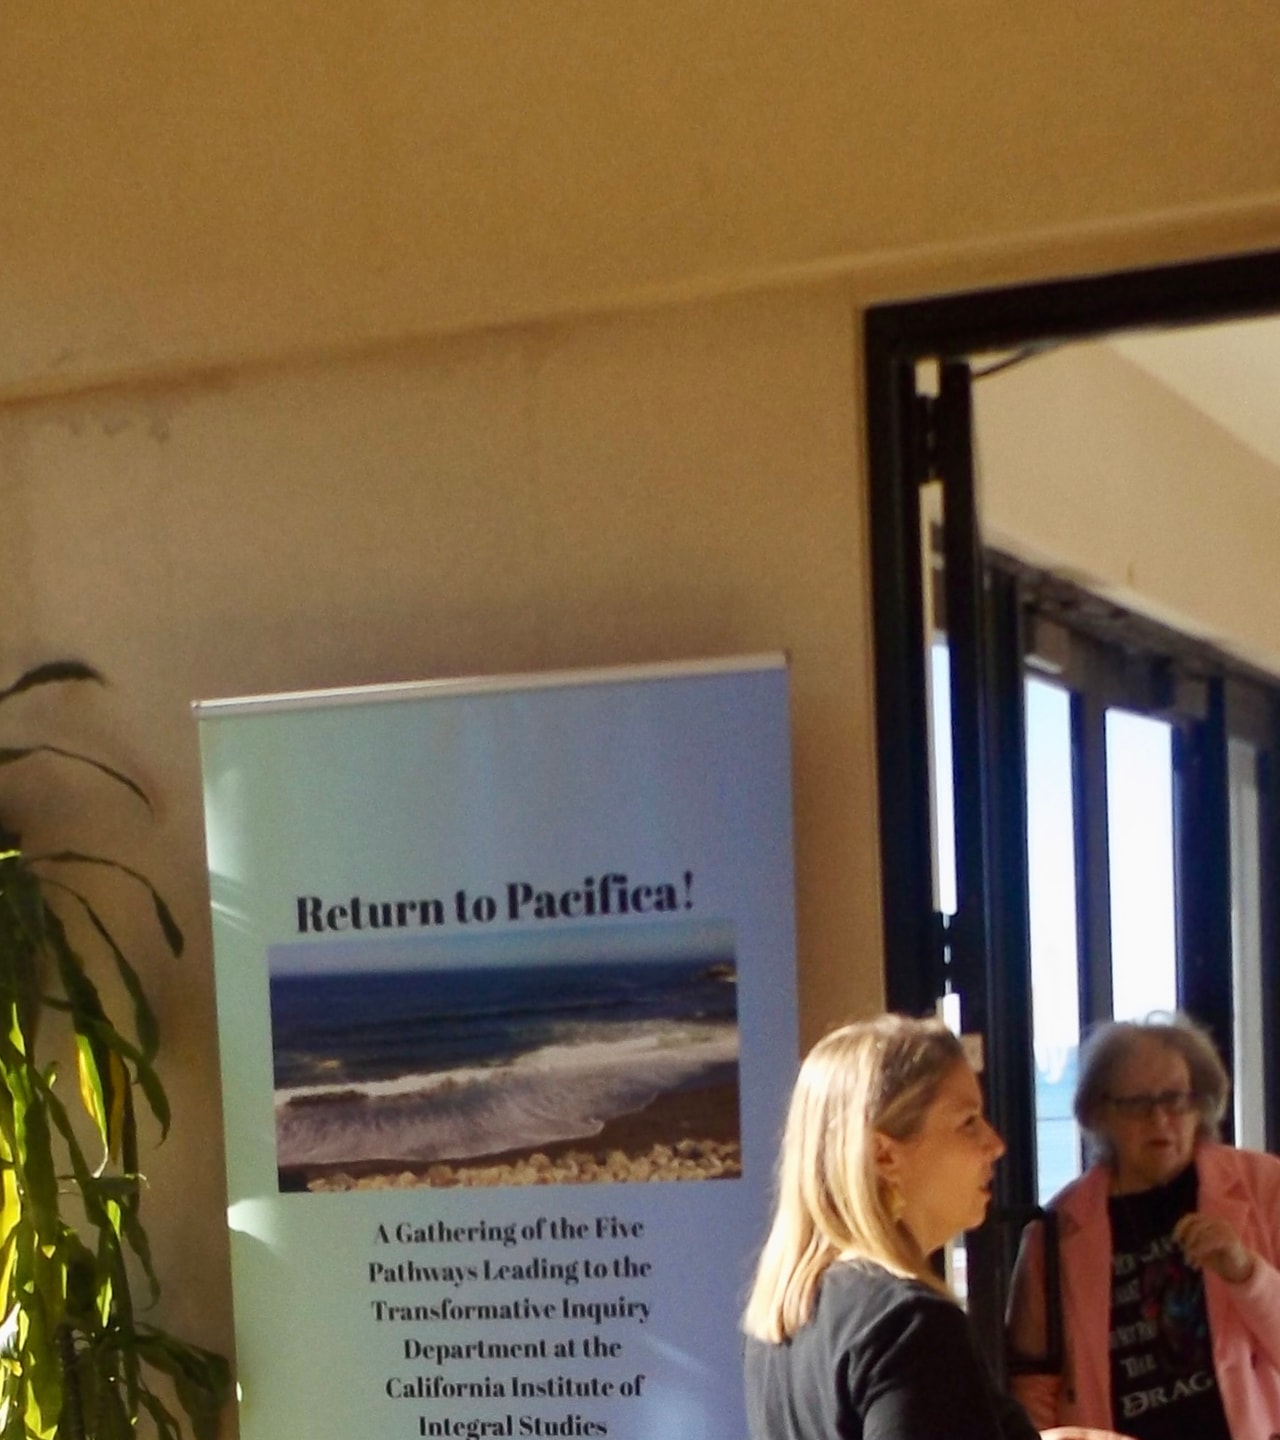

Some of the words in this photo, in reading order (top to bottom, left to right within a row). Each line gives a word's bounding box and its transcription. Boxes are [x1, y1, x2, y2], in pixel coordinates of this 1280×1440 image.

[296, 896, 444, 933] Return
[455, 889, 497, 924] to
[506, 870, 693, 921] Pacifica!
[374, 1224, 392, 1244] A
[395, 1220, 517, 1247] Gathering
[521, 1217, 547, 1240] of
[550, 1217, 589, 1240] the
[595, 1216, 644, 1239] Five
[369, 1260, 478, 1288] Pathways
[483, 1257, 580, 1286] Leading
[583, 1259, 608, 1278] to
[613, 1255, 652, 1278] the
[371, 1298, 556, 1322] Transformative
[562, 1296, 652, 1325] Inquiry
[404, 1339, 546, 1366] Department
[553, 1339, 575, 1358] at
[582, 1335, 622, 1358] the
[385, 1376, 505, 1399] California
[511, 1376, 614, 1398] Institute
[619, 1374, 646, 1397] of
[1122, 1371, 1213, 1419] DRAG
[519, 1414, 608, 1437] Studies
